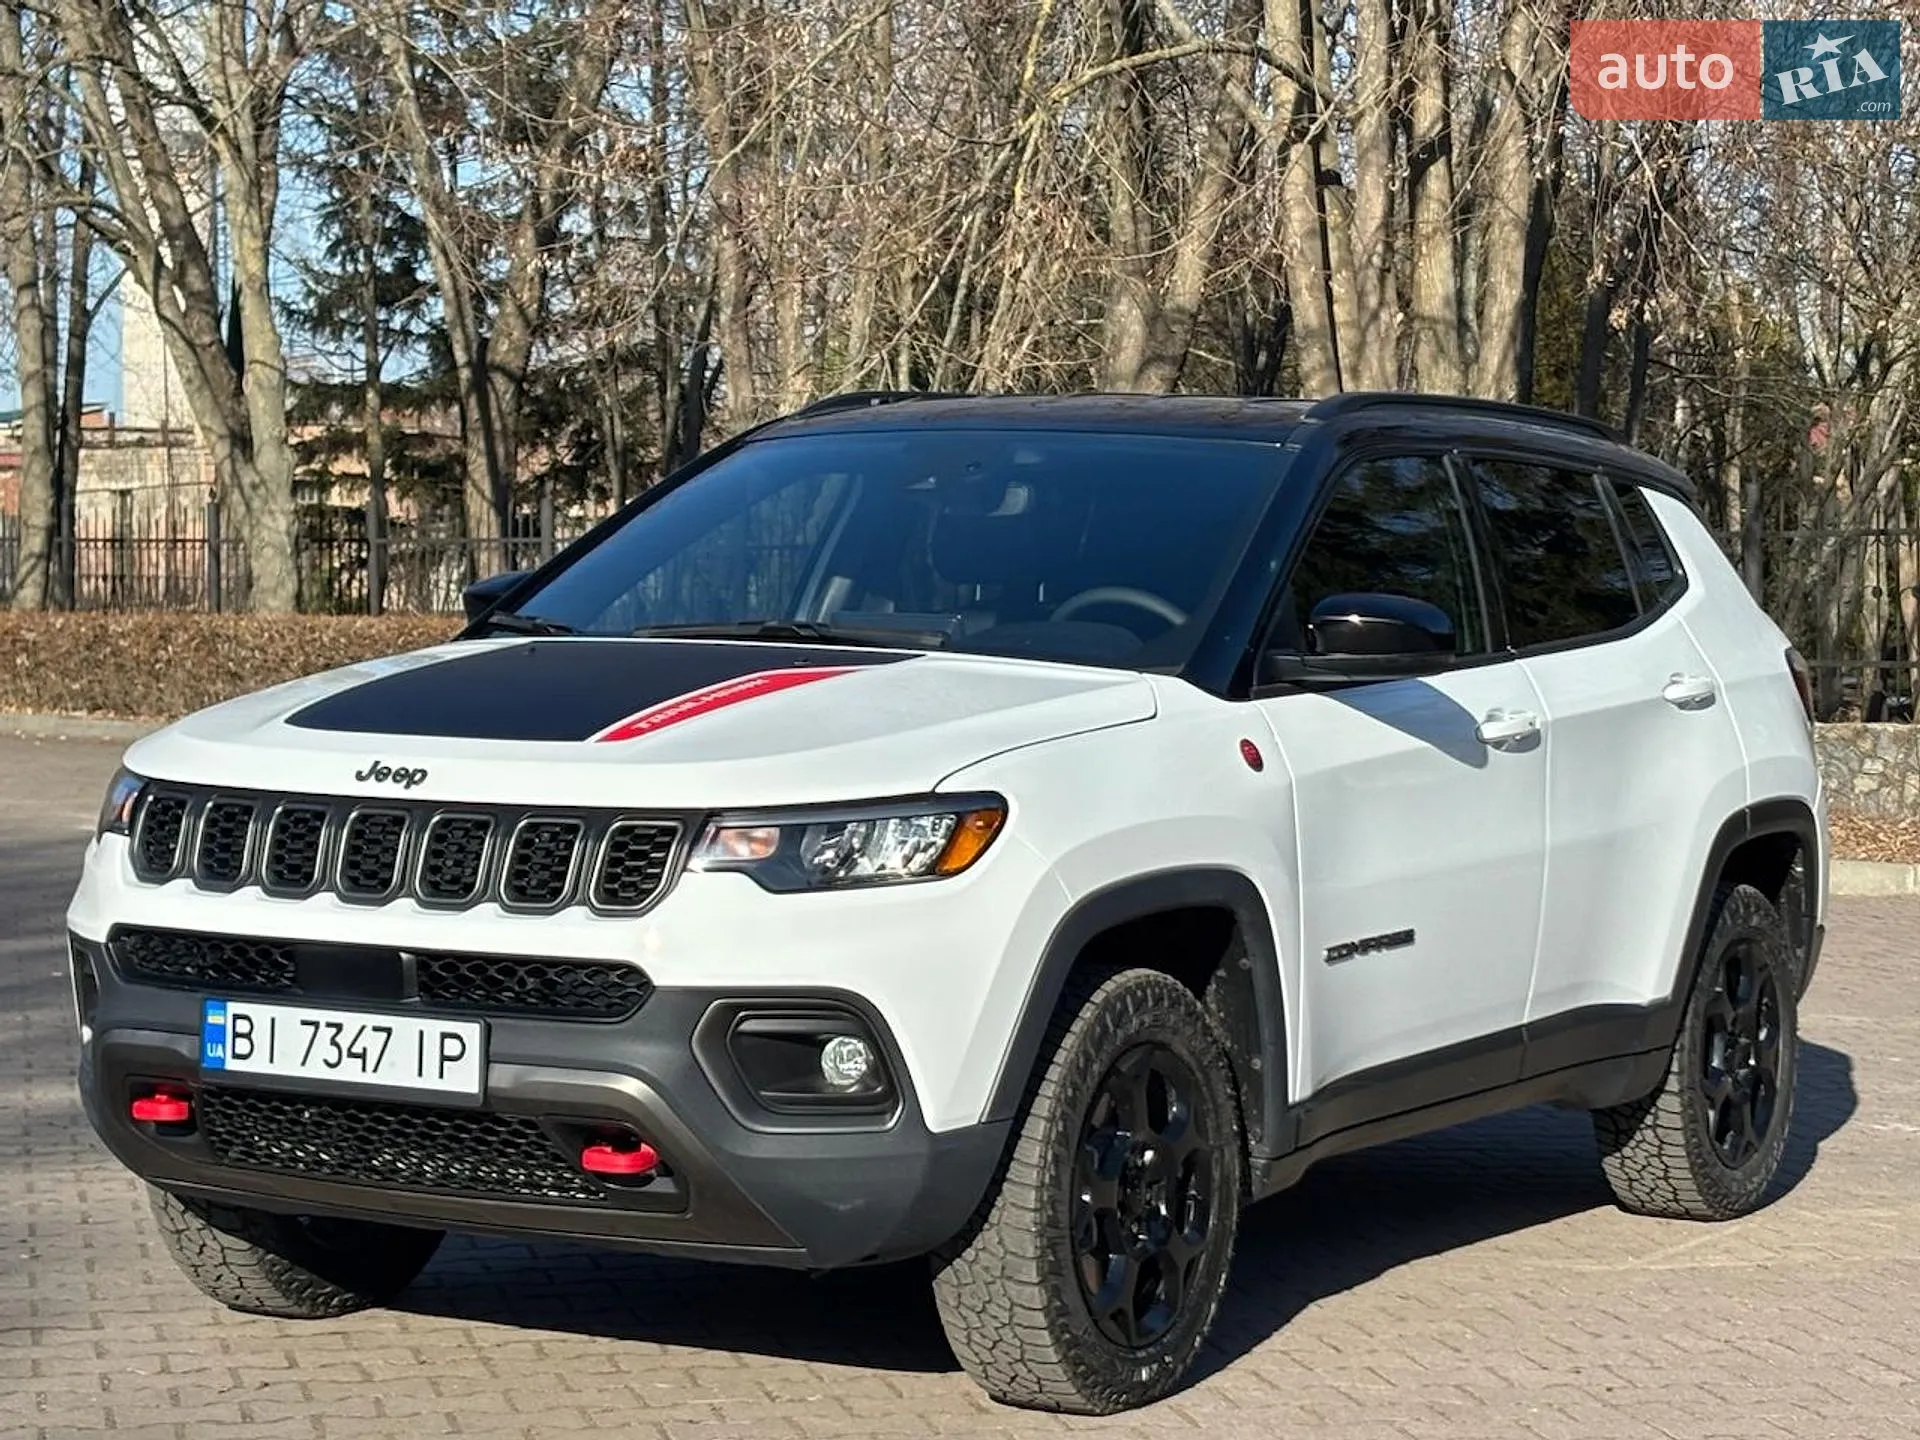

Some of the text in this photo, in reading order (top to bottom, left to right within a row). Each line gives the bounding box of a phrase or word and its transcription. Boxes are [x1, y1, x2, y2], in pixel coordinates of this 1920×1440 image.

[355, 760, 428, 790] Jeep
[207, 1042, 225, 1060] UA
[231, 1013, 467, 1080] BI 7347 IP
